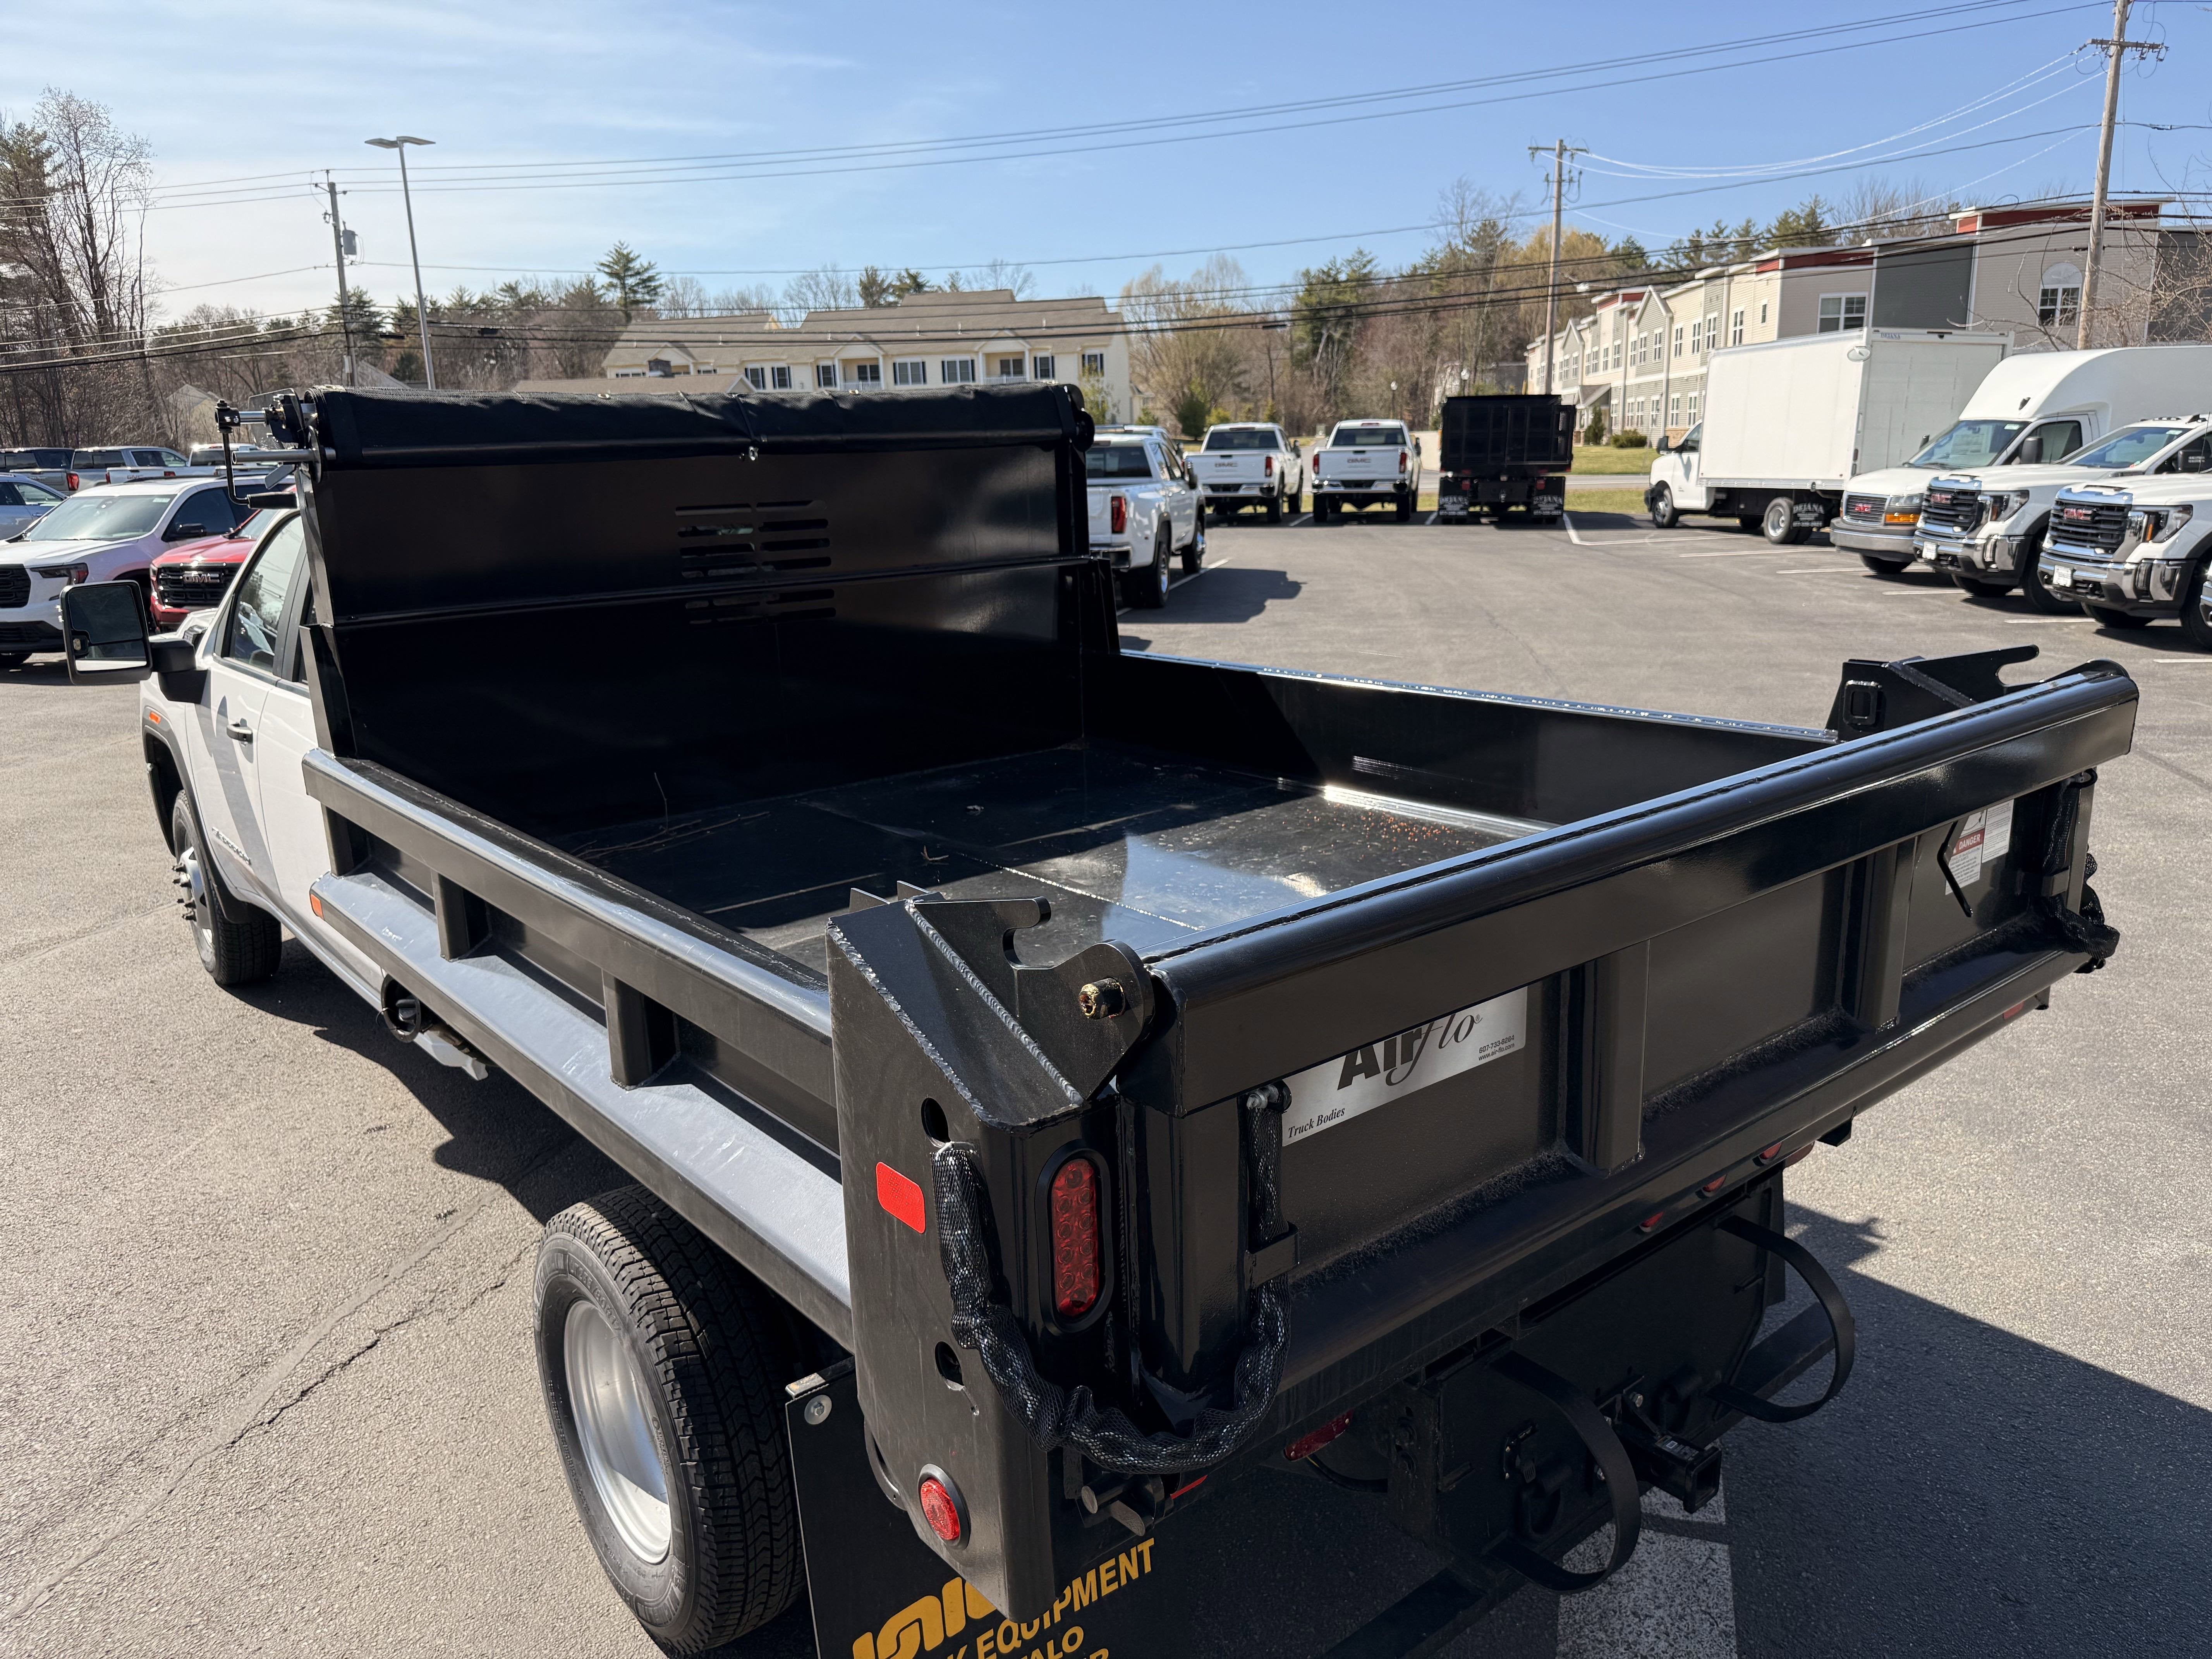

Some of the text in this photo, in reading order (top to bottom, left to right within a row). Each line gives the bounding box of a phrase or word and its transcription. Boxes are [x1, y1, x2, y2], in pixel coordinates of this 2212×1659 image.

[1793, 503, 1825, 515] DEJANA
[2064, 508, 2092, 521] GMC
[183, 573, 220, 583] GMC
[1959, 834, 1981, 850] DANGER
[1288, 1108, 1345, 1138] Truck Bodies
[976, 1537, 1154, 1659] EQUIPMENT
